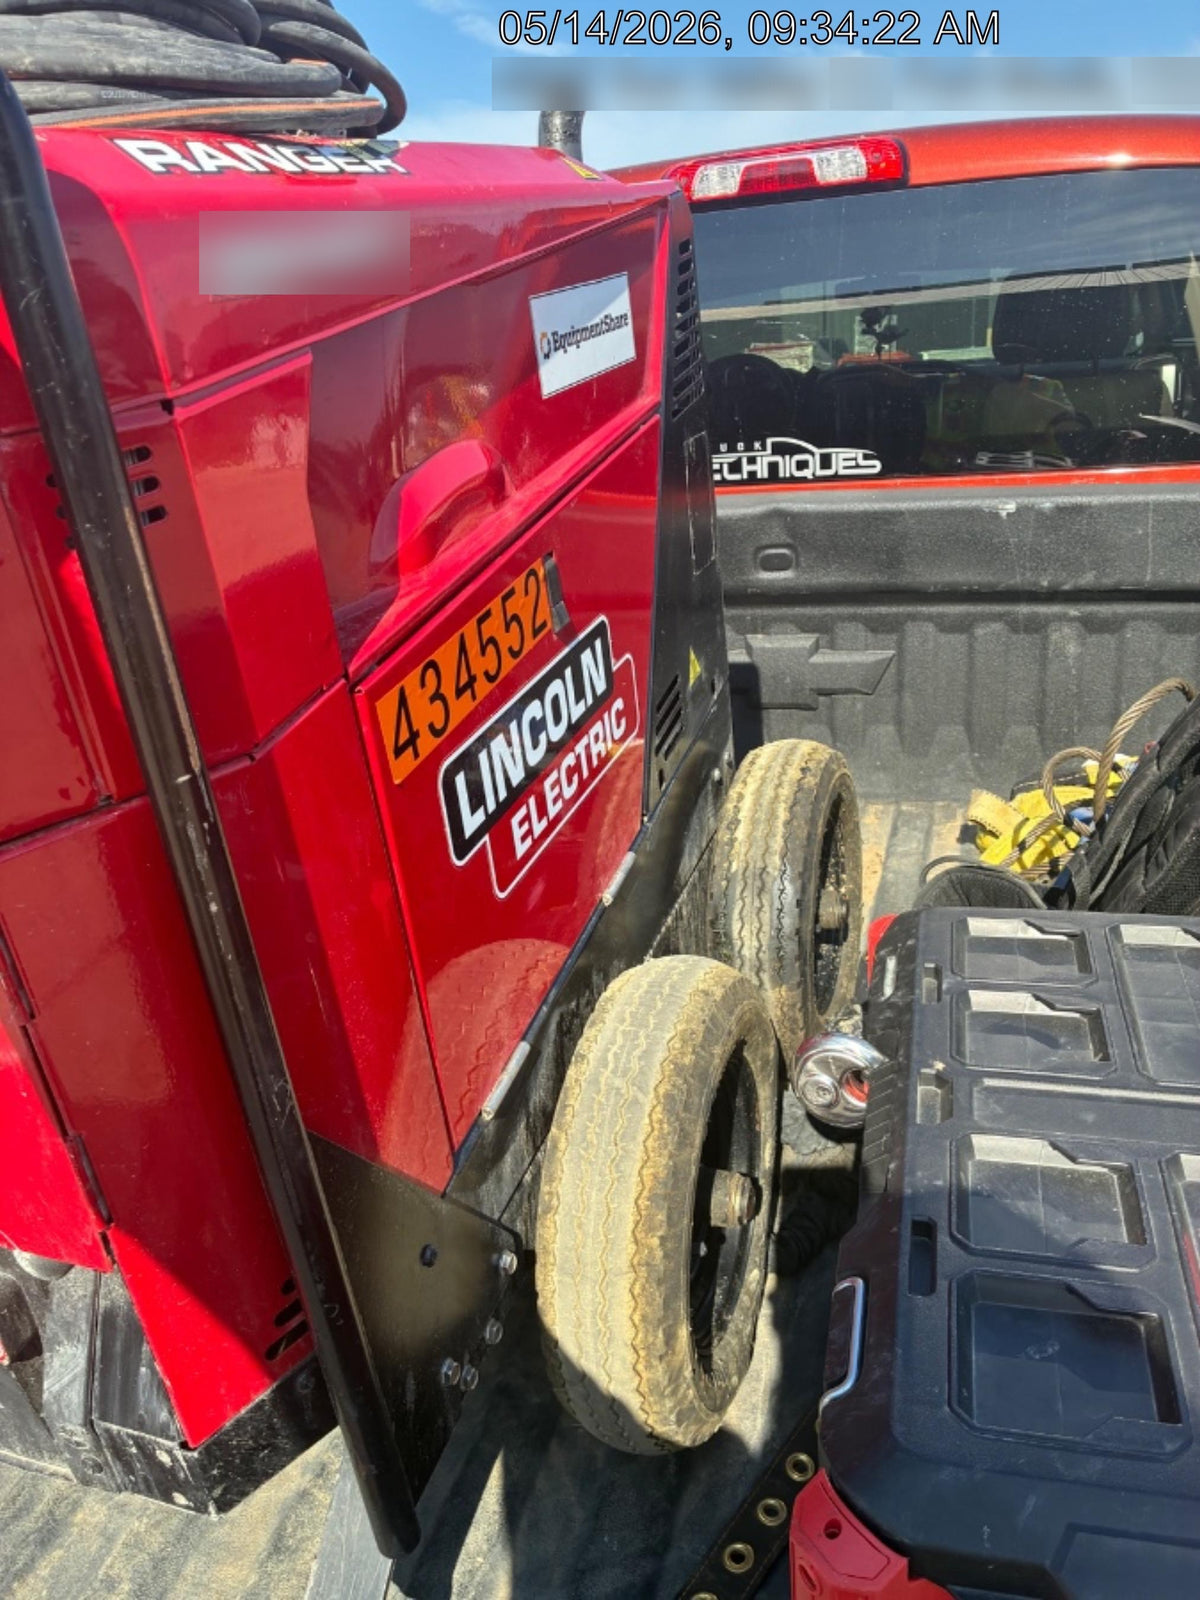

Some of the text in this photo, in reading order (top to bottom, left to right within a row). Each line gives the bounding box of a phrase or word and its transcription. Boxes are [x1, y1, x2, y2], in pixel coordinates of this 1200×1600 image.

[113, 138, 409, 173] RANGER
[551, 312, 628, 354] EquipmentShare
[712, 452, 882, 481] ECHNIQUES
[720, 441, 762, 452] UCK
[393, 567, 549, 761] 434552
[454, 637, 608, 839] LINCOLN
[509, 697, 627, 860] ELECTRIC
